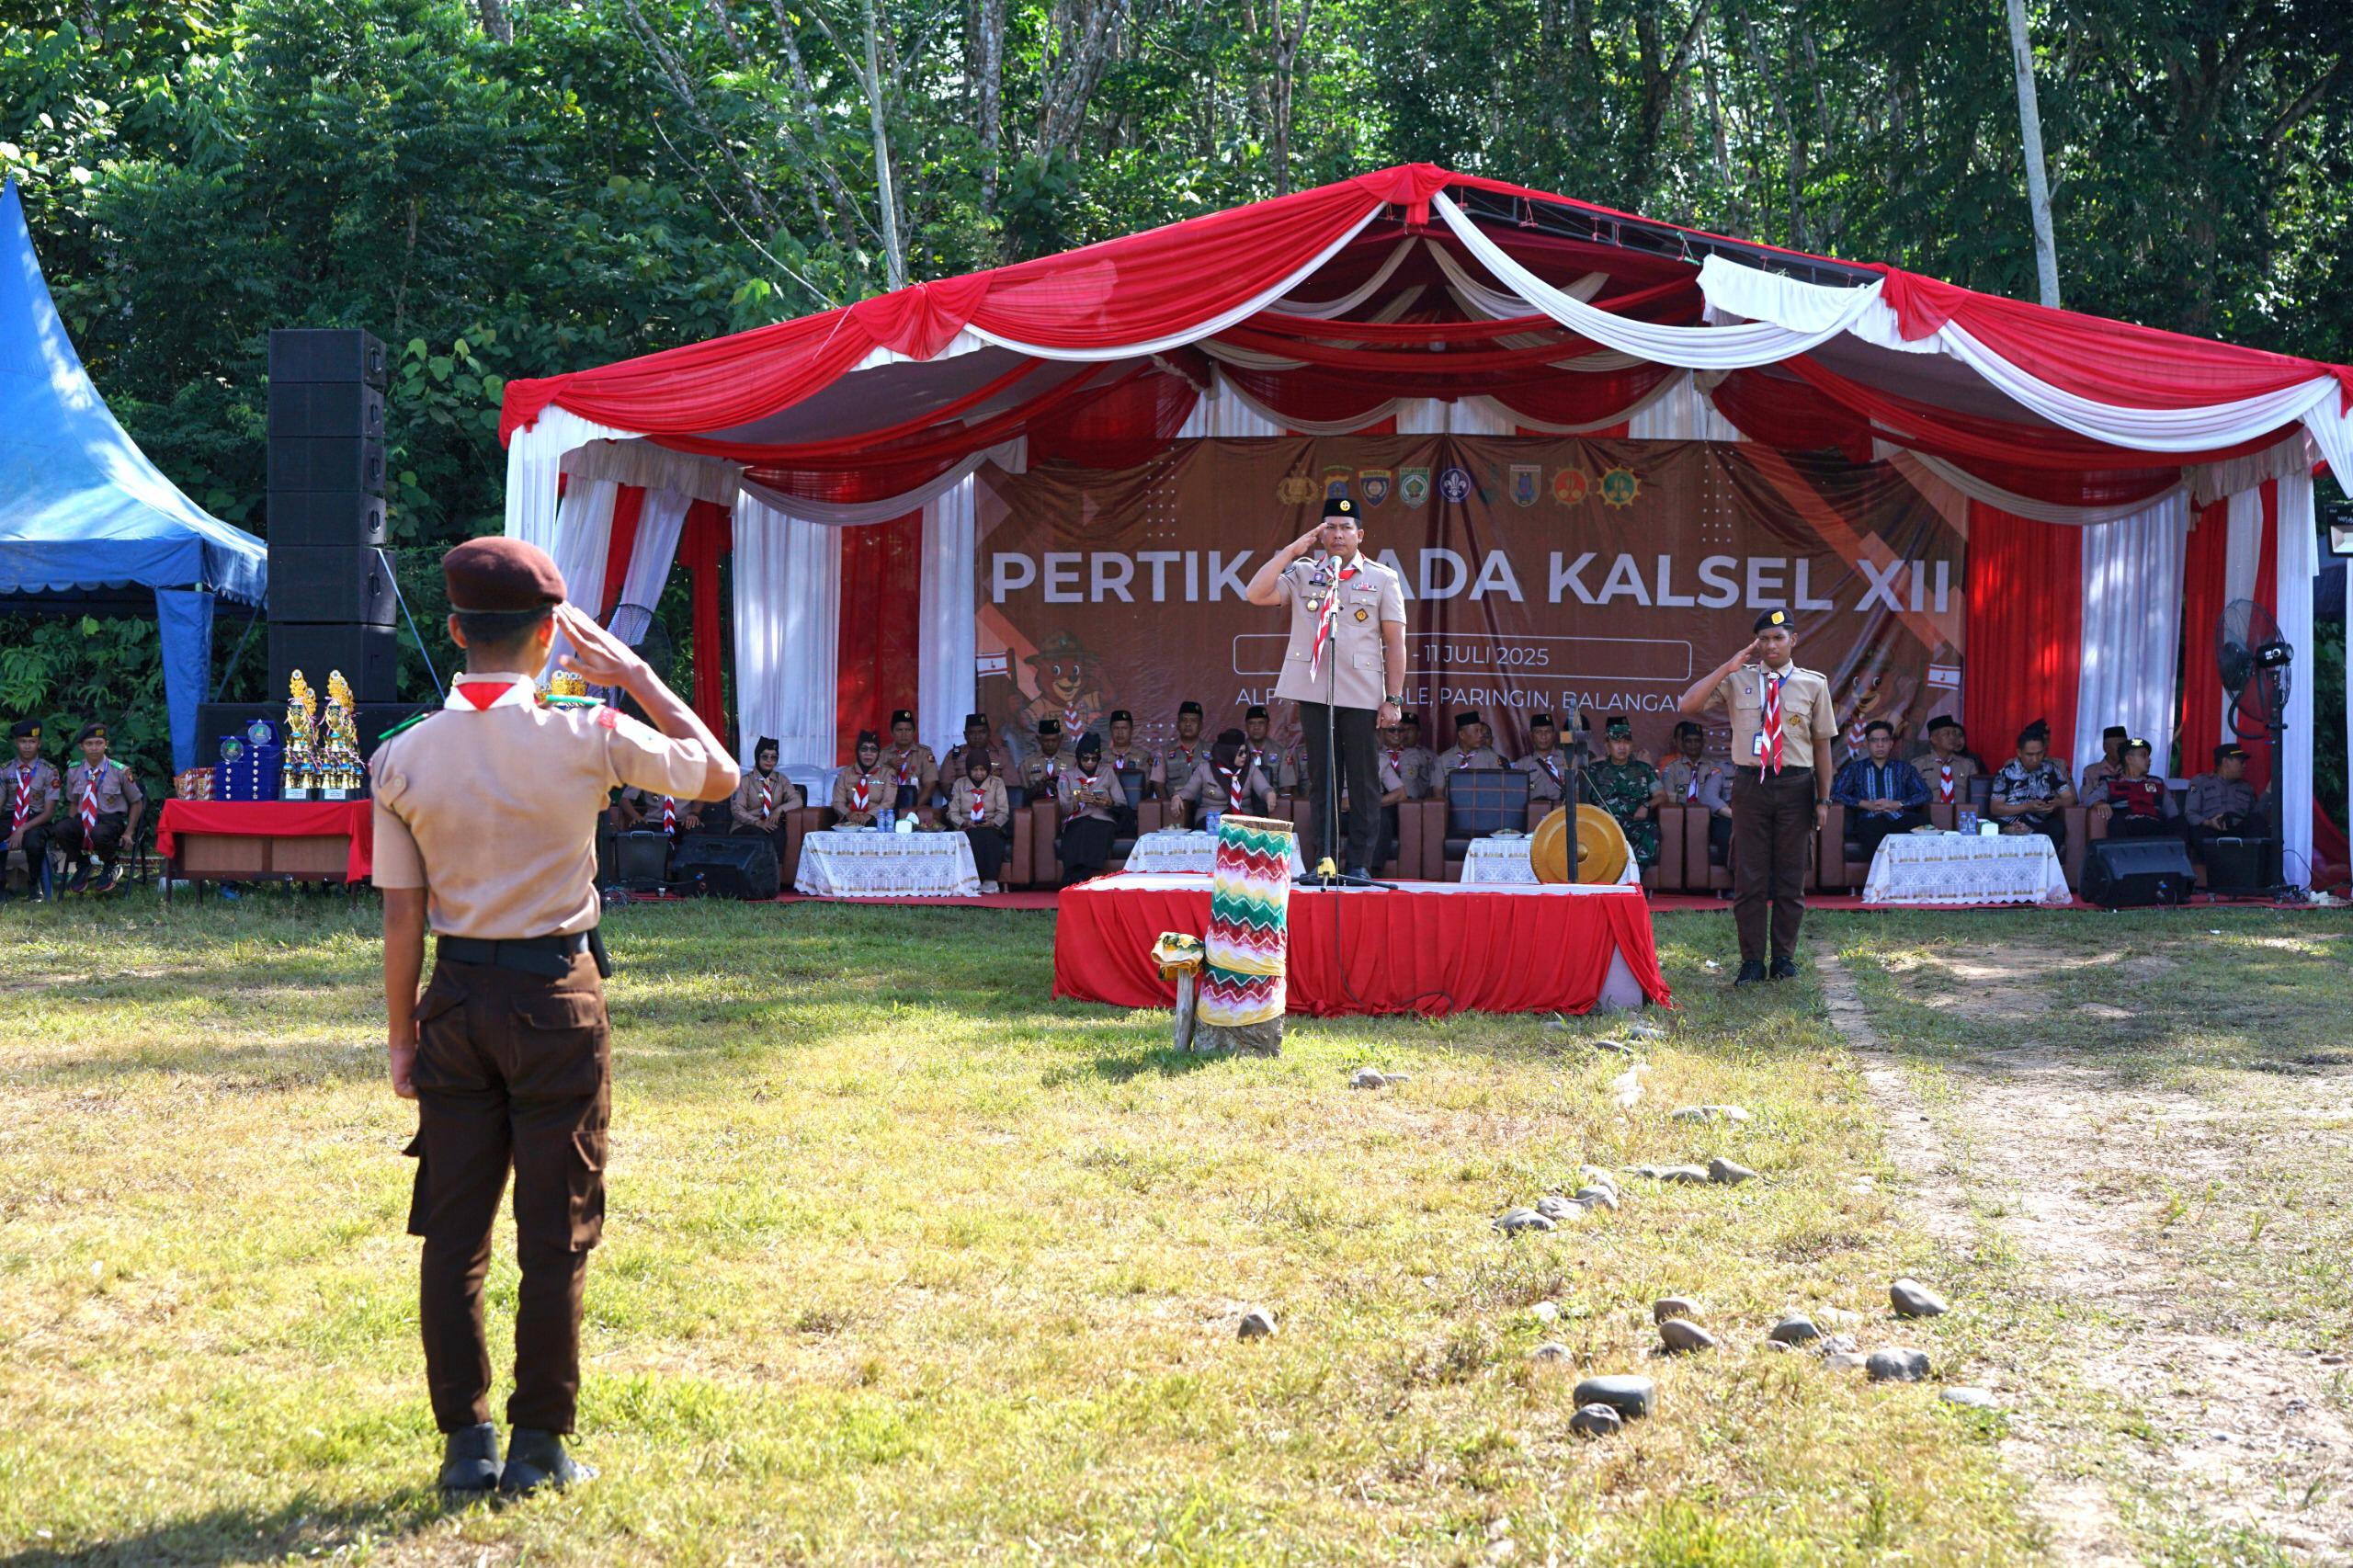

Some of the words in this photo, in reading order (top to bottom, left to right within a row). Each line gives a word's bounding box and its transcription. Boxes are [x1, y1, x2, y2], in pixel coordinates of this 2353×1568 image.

[993, 548, 1524, 603] PERTIKADA
[1549, 551, 1833, 610] KALSEL
[1854, 559, 1949, 612] XII
[1424, 644, 1438, 662] 11
[1443, 645, 1490, 665] JULI
[1496, 647, 1550, 666] 2025
[1235, 687, 1293, 705] ALF
[1440, 687, 1555, 711] PARINGIN,
